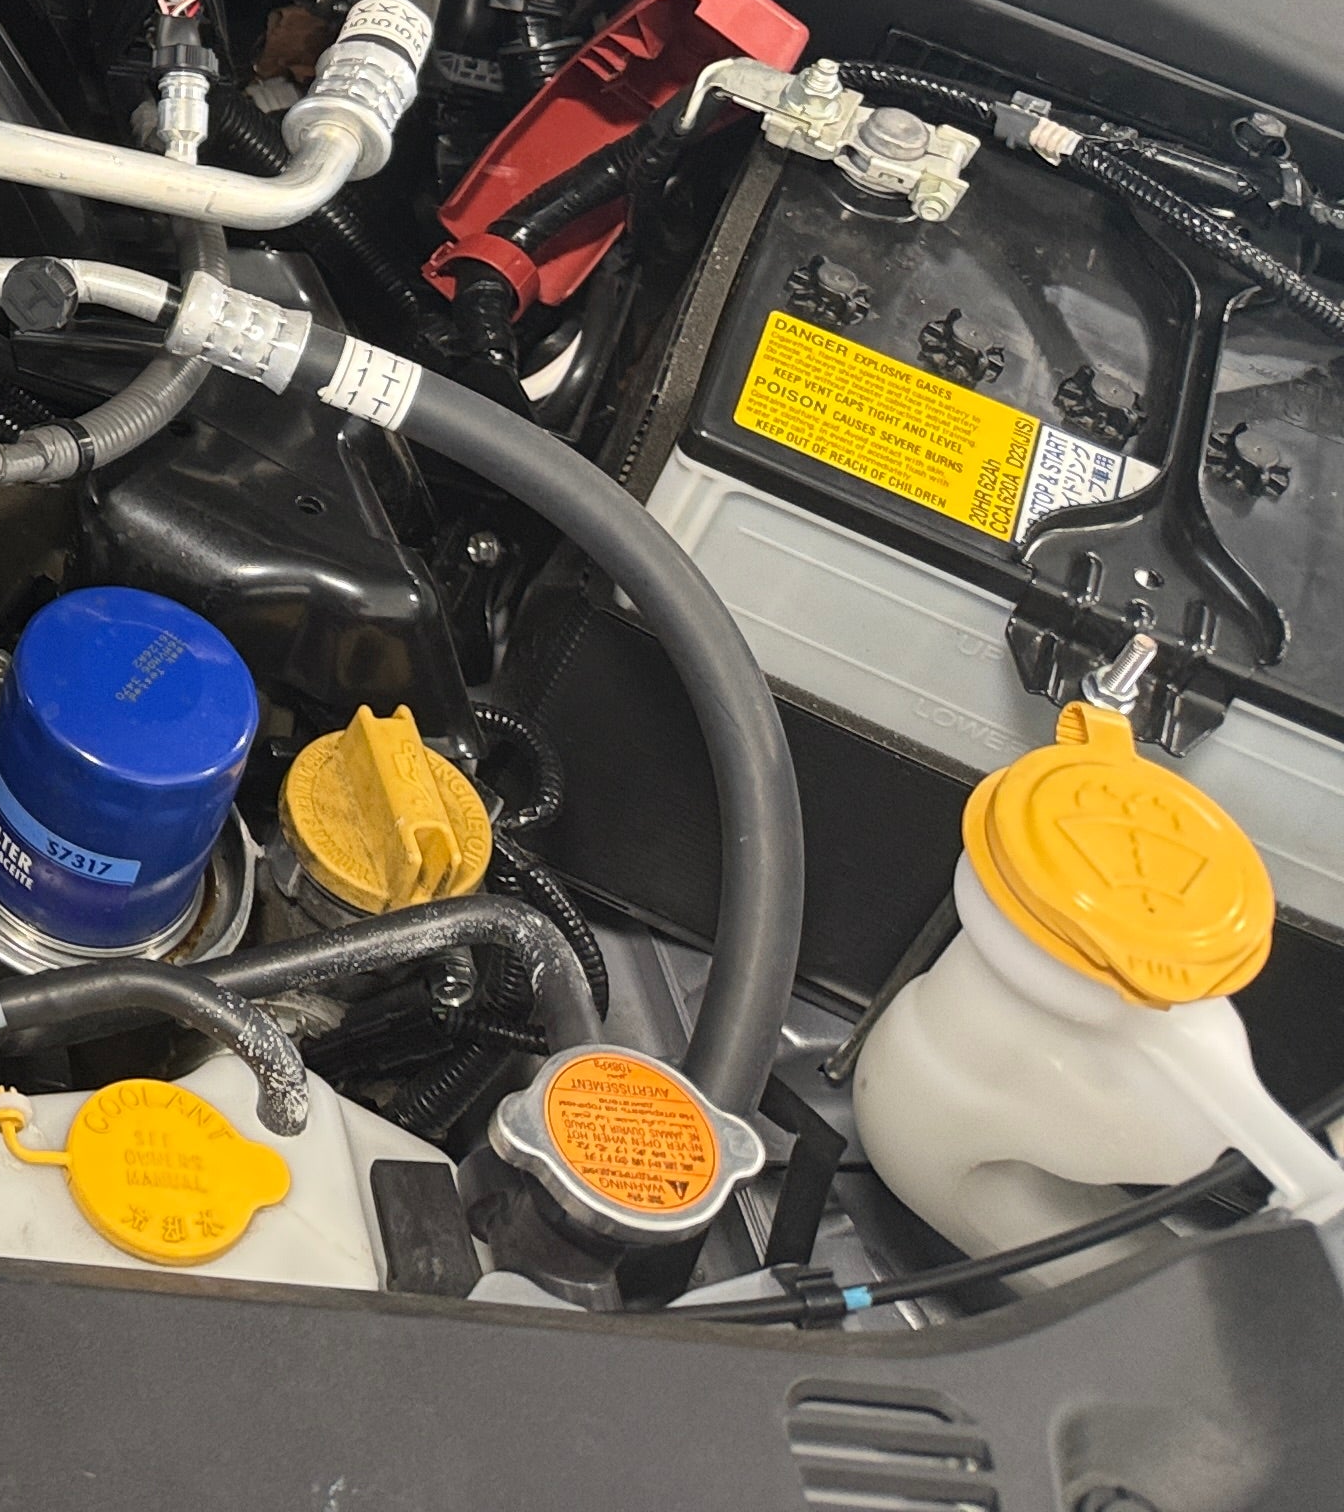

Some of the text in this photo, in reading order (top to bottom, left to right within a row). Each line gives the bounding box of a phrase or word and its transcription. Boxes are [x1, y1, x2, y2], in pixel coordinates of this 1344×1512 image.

[774, 317, 952, 400] DANGER EXPLOSIVE GASES
[753, 375, 963, 473] POISON CAUSES SEVERE BURNS
[773, 366, 963, 455] KEEP VENT CAPS TIGHT AND LEVEL
[755, 418, 784, 436] KEEP
[785, 431, 810, 448] OUT
[828, 450, 868, 474] REACH
[888, 475, 946, 508] CHILDREN
[988, 417, 1034, 534] CCA 620A D23(JIS)
[1036, 470, 1060, 487] &
[1038, 430, 1069, 475] START
[968, 458, 1001, 526] 20HR 62Ah
[46, 839, 112, 876] S7317
[84, 1086, 234, 1141] COOLANT
[571, 1078, 670, 1101] AVERTISSEMENT
[591, 1130, 628, 1145] WHEN
[597, 1176, 666, 1194] WARNING
